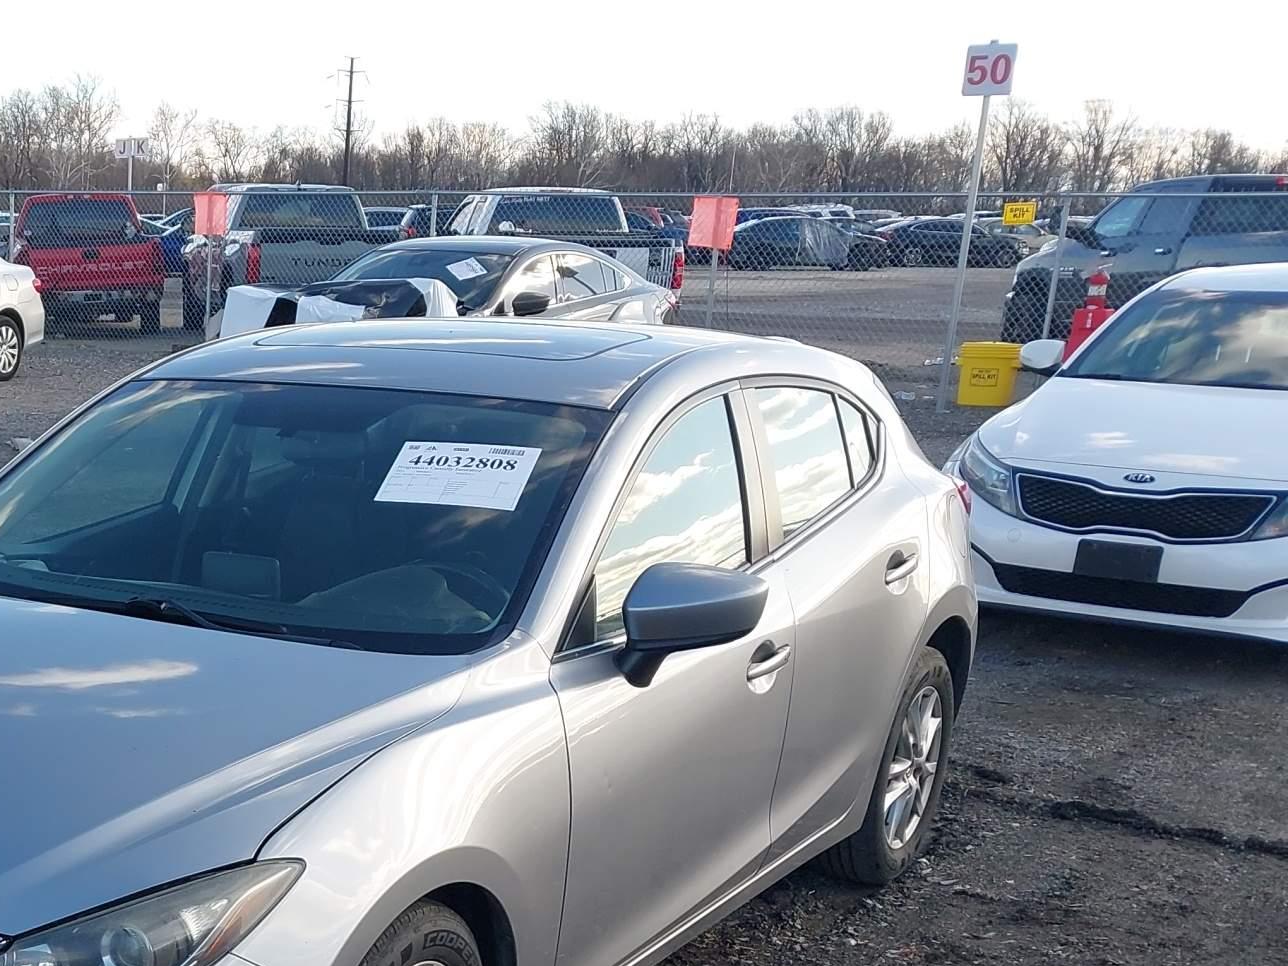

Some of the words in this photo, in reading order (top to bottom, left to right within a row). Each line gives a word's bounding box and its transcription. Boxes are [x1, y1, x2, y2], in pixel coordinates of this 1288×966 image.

[967, 53, 1012, 86] 50
[119, 140, 126, 154] J
[136, 140, 145, 154] K
[36, 261, 146, 274] CHEVROLET
[408, 454, 518, 471] 44032808
[1128, 473, 1151, 482] KIA
